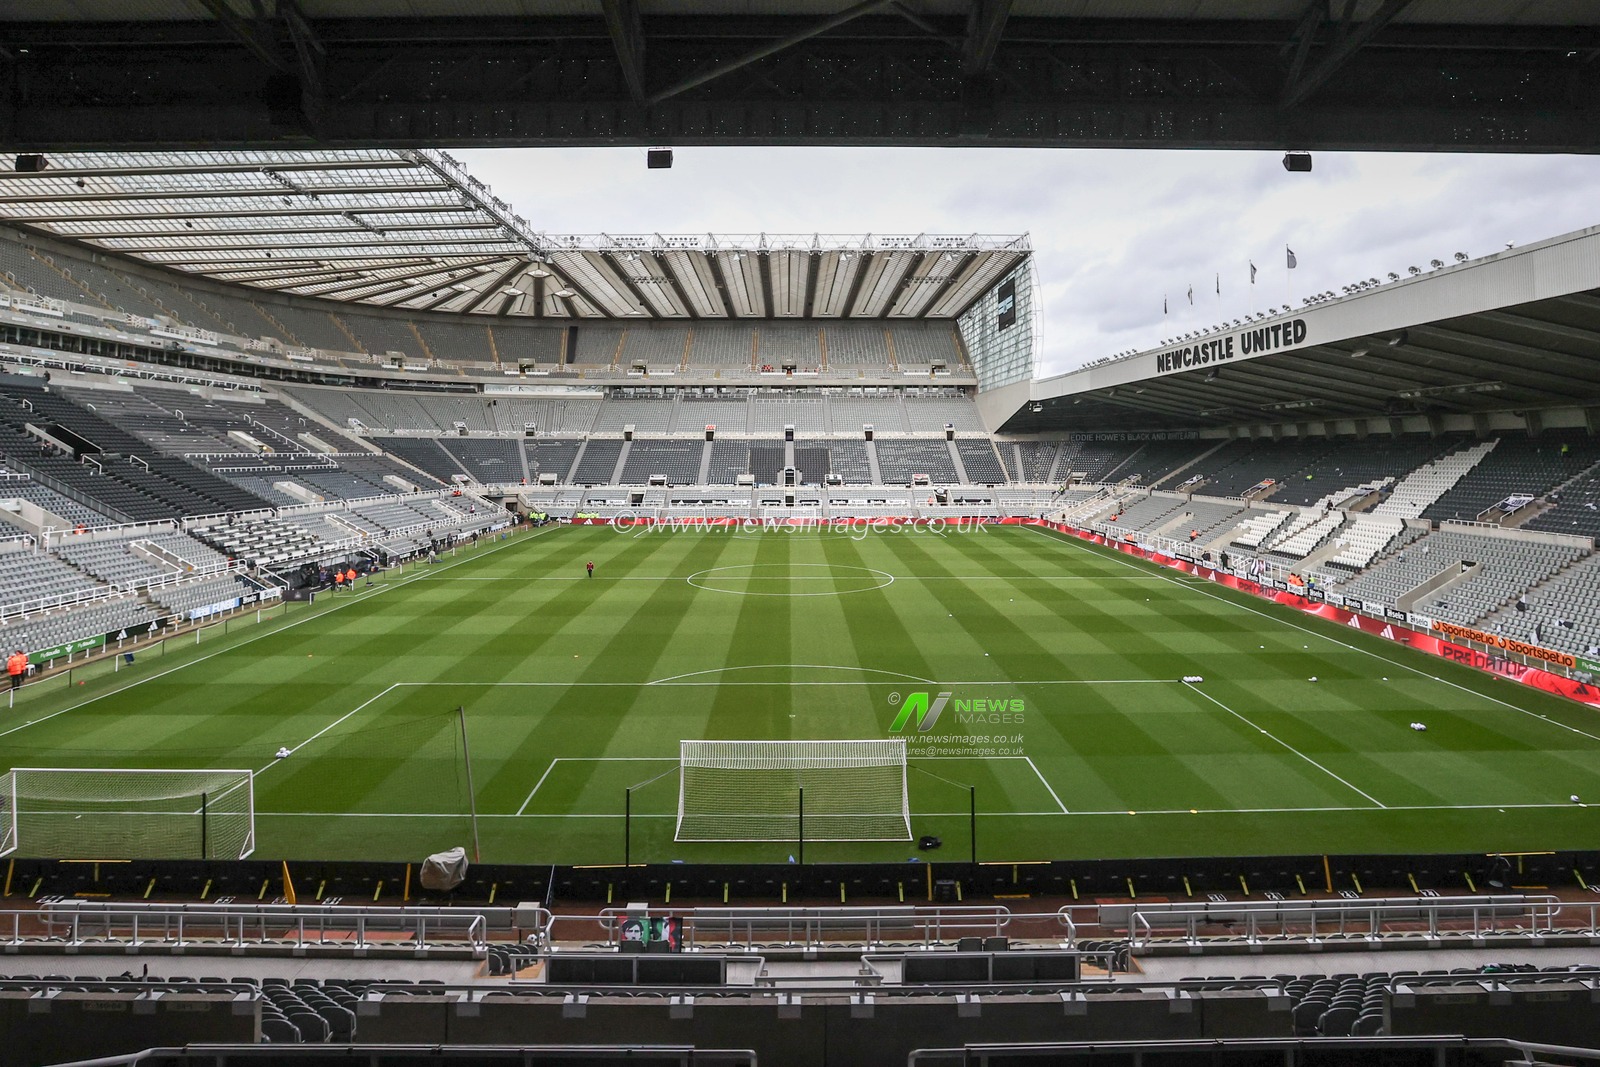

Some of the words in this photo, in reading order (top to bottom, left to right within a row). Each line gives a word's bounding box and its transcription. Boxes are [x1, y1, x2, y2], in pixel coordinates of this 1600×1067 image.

[1157, 336, 1233, 373] NEWCASTLE
[1241, 319, 1306, 354] UNITED
[1070, 433, 1093, 441] EDDIE
[1095, 433, 1125, 441] HOWE'S
[1127, 432, 1149, 440] BLACK
[1151, 432, 1166, 440] AND
[1442, 622, 1495, 645] Sportsbet.io
[1509, 638, 1573, 667] Sportsbet.io
